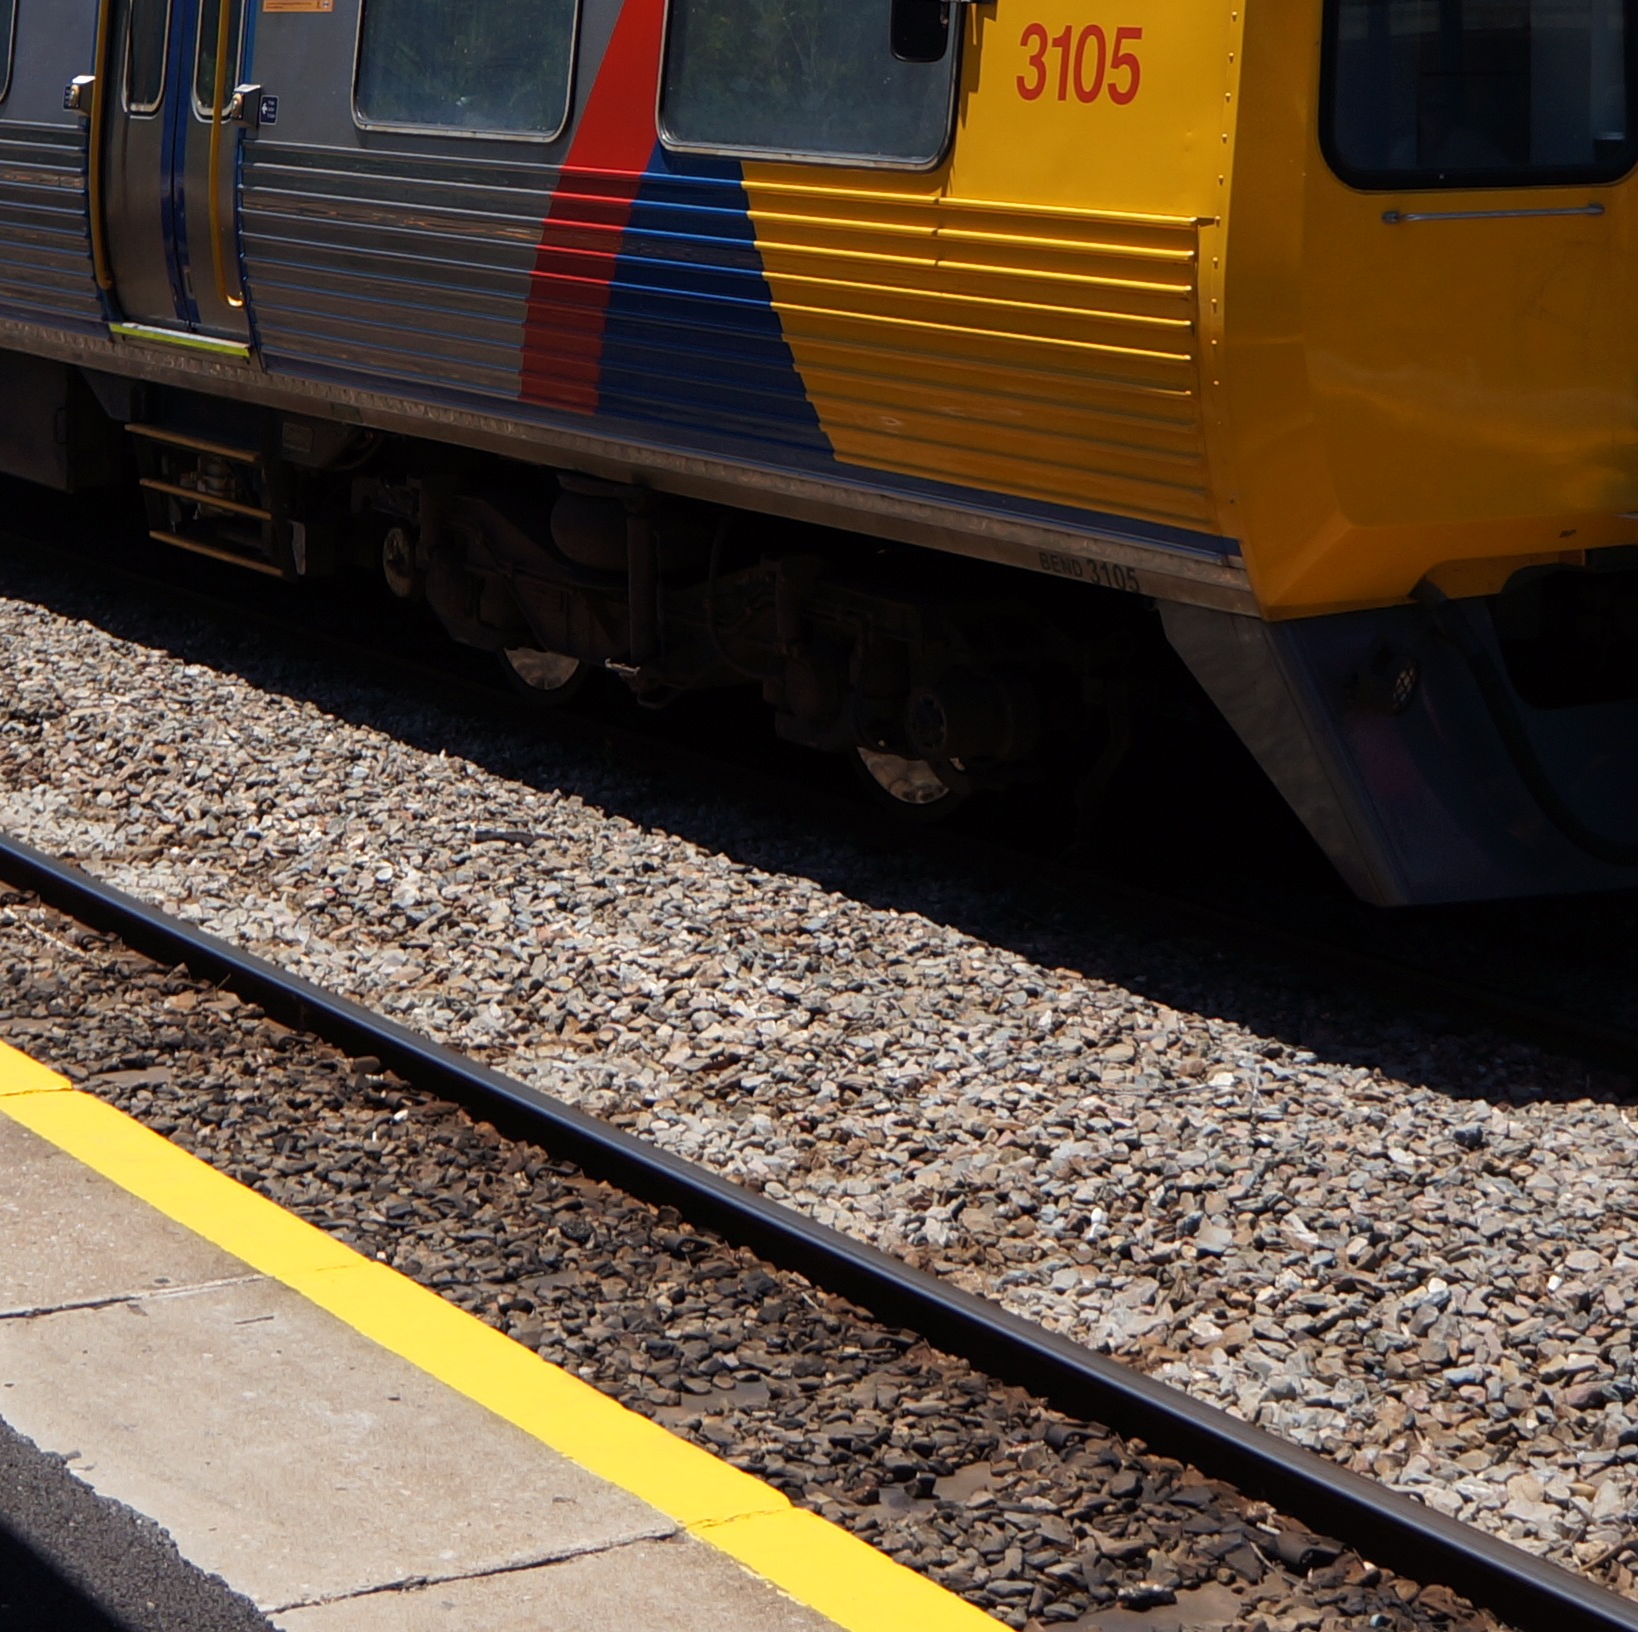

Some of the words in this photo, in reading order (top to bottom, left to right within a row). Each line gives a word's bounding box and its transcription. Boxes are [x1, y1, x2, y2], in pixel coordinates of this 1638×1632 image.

[1016, 22, 1143, 105] 3105
[1038, 551, 1083, 578] BEND
[1086, 558, 1140, 593] 3105
